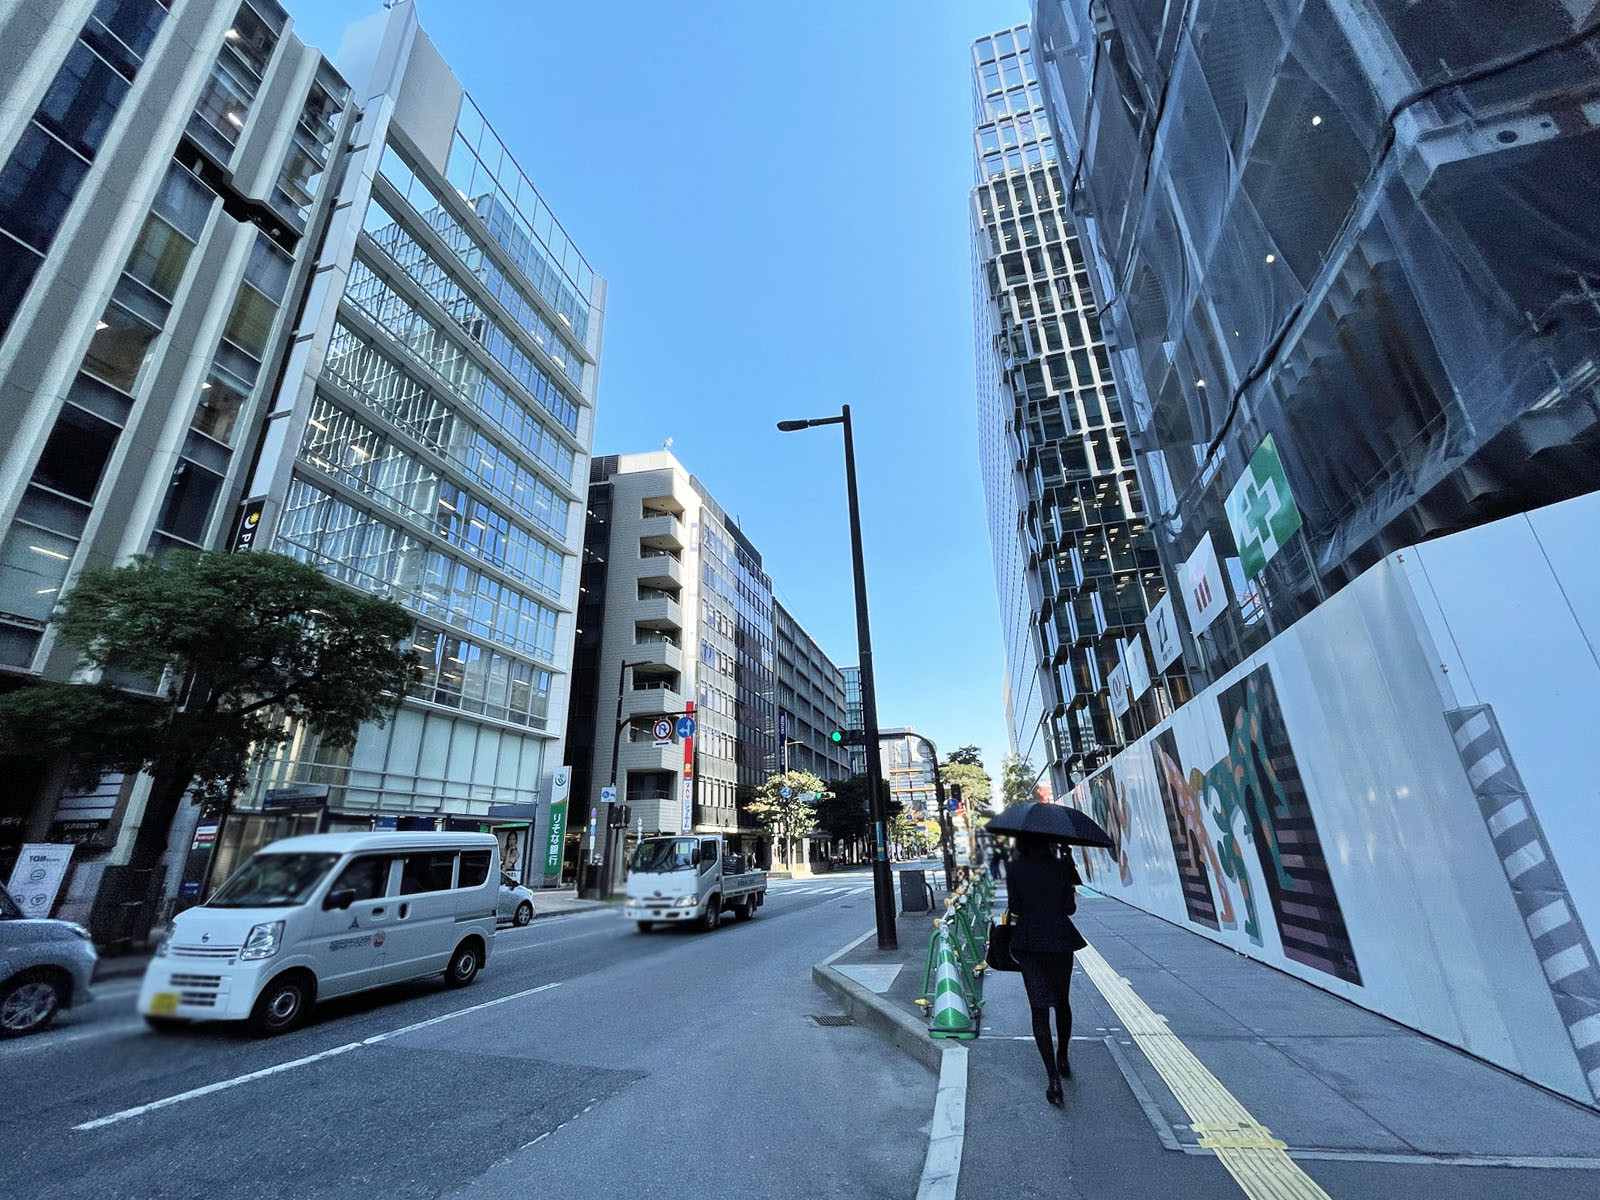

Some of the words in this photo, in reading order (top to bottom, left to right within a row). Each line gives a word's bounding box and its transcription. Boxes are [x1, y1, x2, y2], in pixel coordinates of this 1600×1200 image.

[549, 813, 561, 866] りそな銀行
